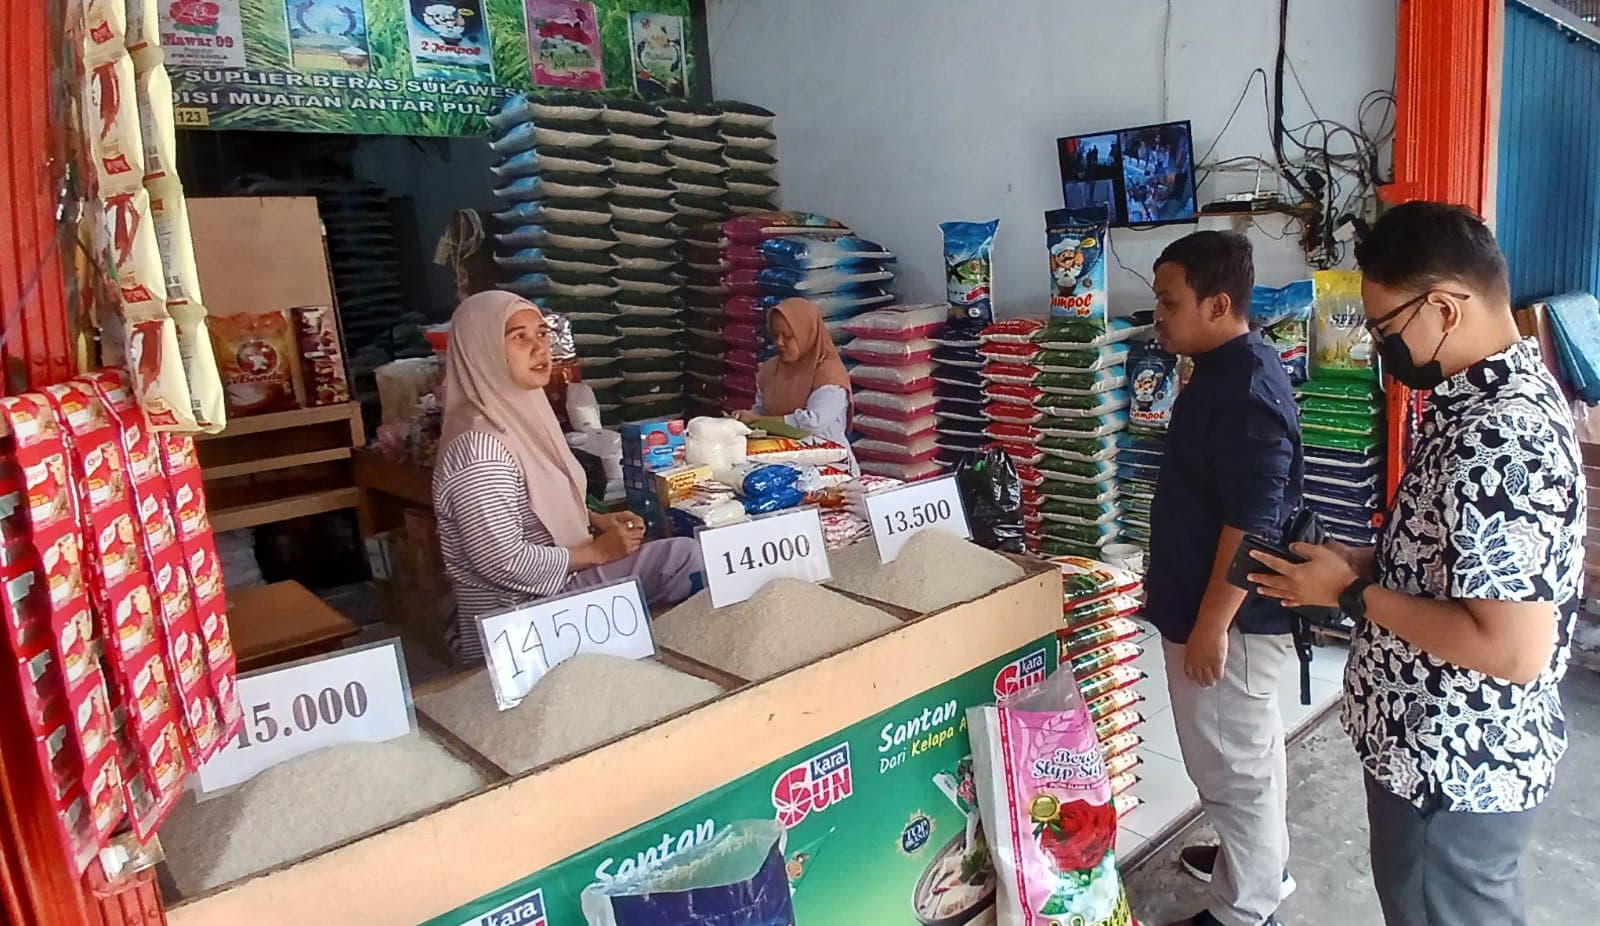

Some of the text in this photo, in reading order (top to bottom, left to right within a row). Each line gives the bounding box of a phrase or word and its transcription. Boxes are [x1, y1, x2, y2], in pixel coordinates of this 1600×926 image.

[162, 33, 213, 47] Mawar
[185, 70, 304, 86] SUPLIER
[312, 75, 399, 91] BERAS
[228, 92, 343, 108] MUATAN
[351, 97, 435, 113] ANTAR
[177, 111, 202, 122] 123
[884, 498, 951, 536] 13.500
[721, 533, 811, 576] 14.000
[1021, 655, 1043, 674] kara
[878, 699, 957, 752] Santan
[879, 746, 906, 774] Dari
[911, 726, 954, 757] Kelapa
[813, 751, 845, 776] kara
[774, 764, 853, 827] SUN
[905, 819, 928, 841] TOP
[595, 818, 715, 890] Santan
